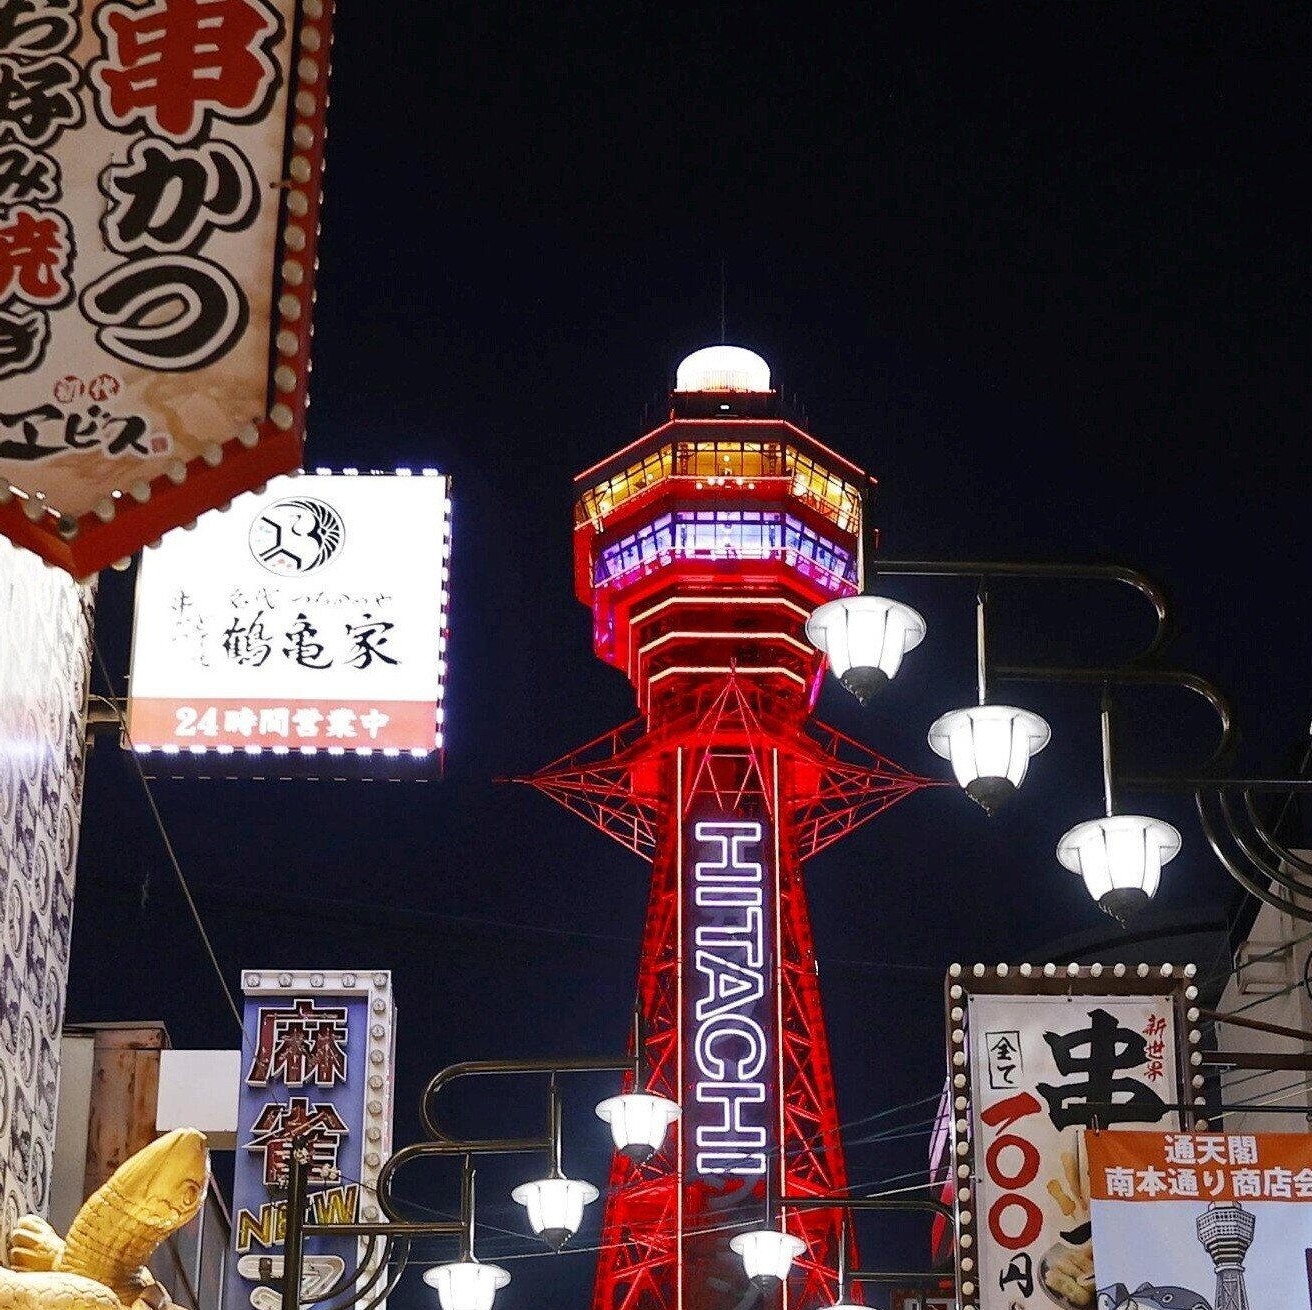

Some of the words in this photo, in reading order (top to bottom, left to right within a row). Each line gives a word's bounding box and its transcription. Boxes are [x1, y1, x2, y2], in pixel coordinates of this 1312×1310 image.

[81, 0, 279, 371] 串かつ
[222, 610, 402, 670] 鶴亀家
[175, 705, 390, 738] 24時間営業中
[694, 820, 767, 1175] HITACHI
[989, 1035, 1017, 1086] 全て
[1142, 1013, 1167, 1083] 新世界
[243, 999, 350, 1187] 麻雀
[1163, 1134, 1258, 1166] 通天閣
